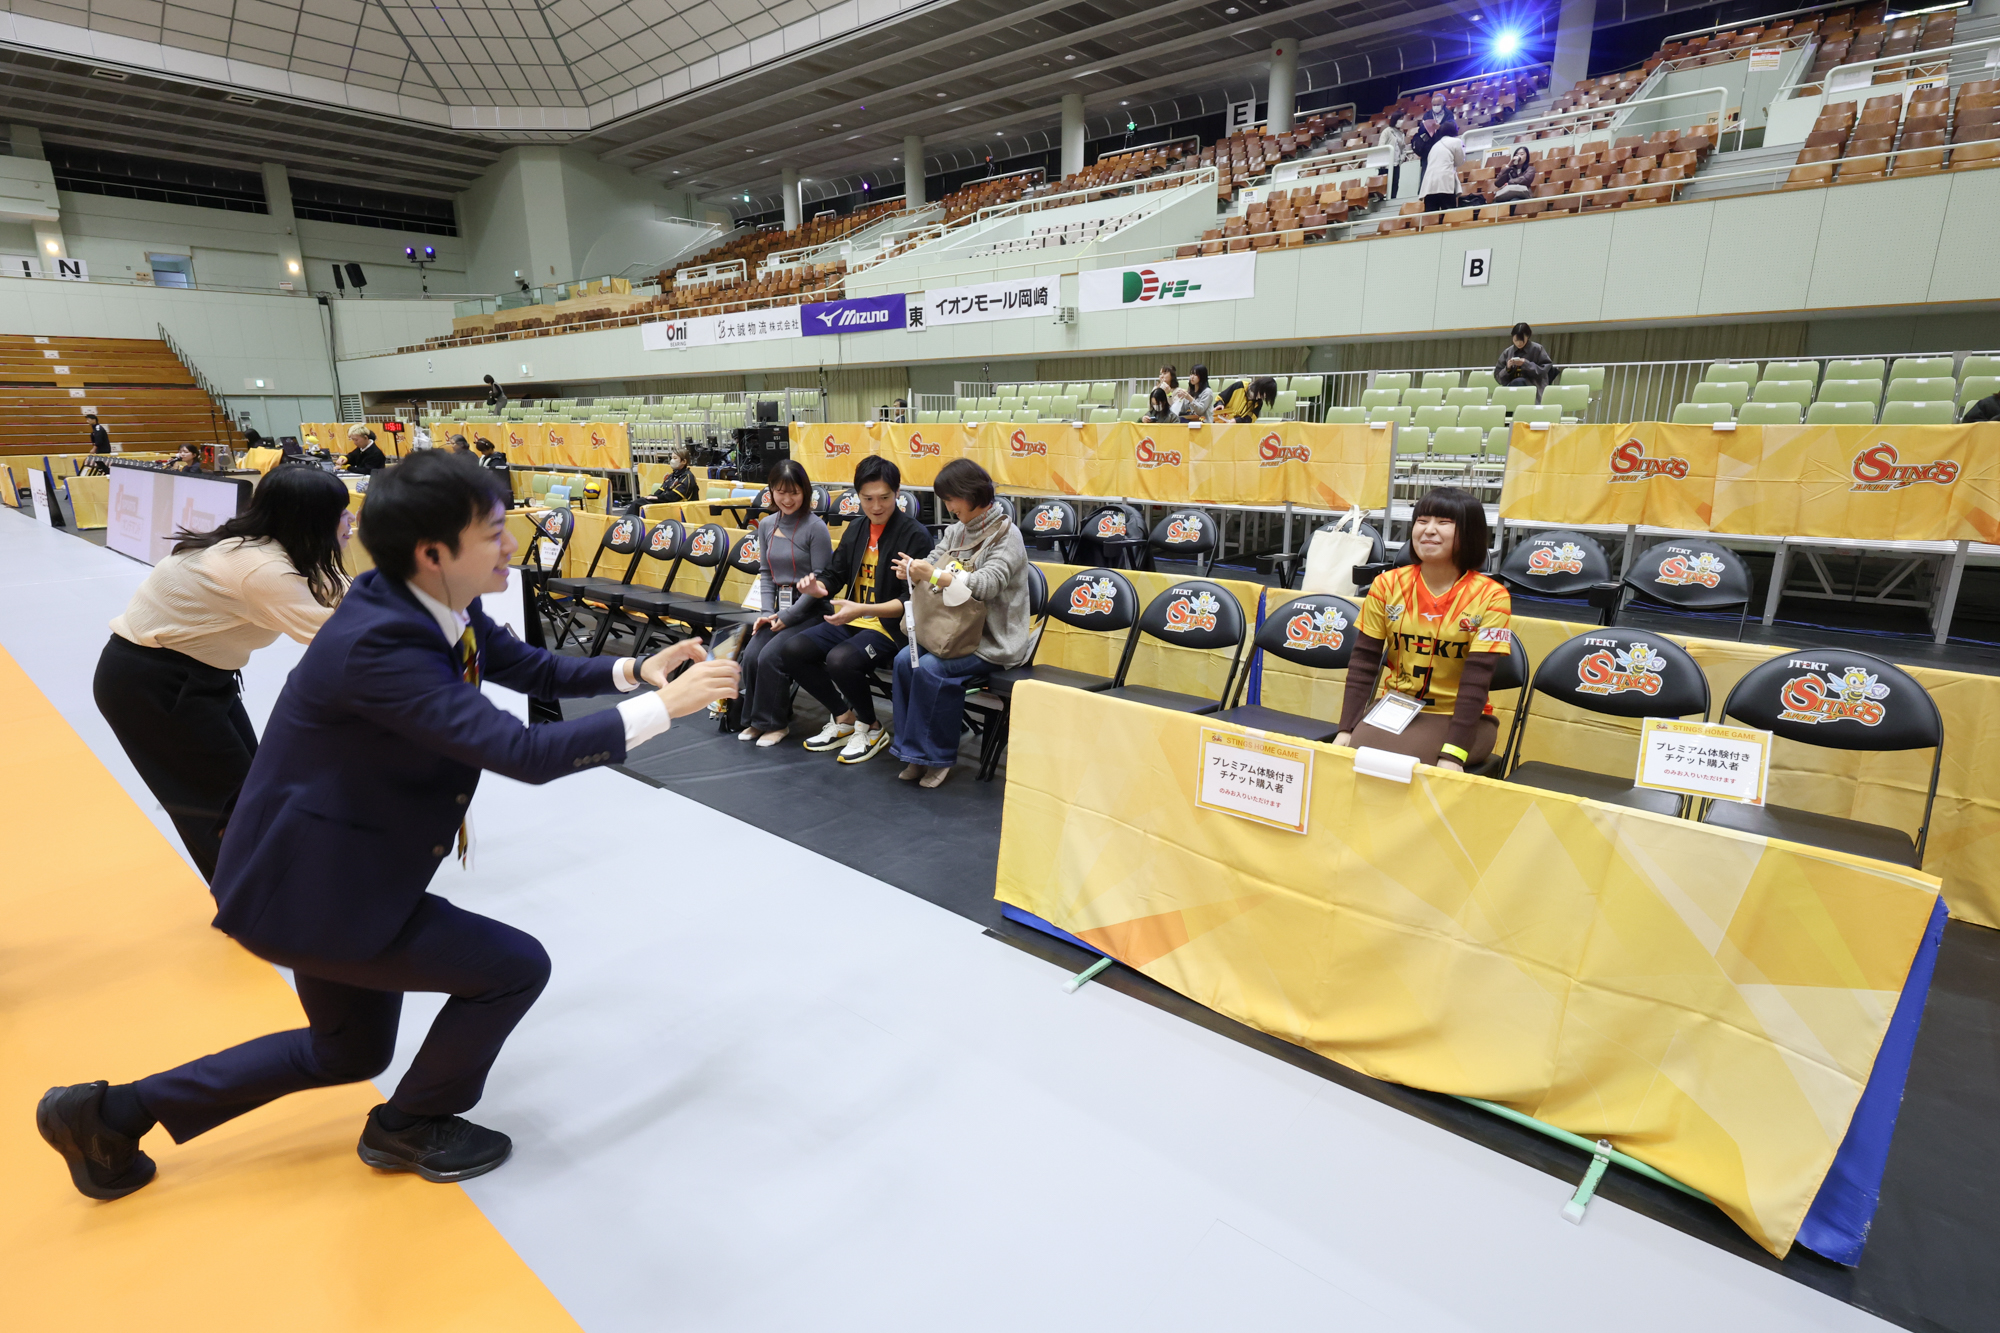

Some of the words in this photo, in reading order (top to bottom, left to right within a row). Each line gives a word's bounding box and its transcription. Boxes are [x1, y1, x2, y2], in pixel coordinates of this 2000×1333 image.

[1233, 102, 1248, 125] E
[1469, 258, 1484, 277] B
[1158, 279, 1202, 299] ドミー
[935, 286, 1049, 316] イオンモール岡崎
[838, 309, 889, 326] MIZUNO
[908, 307, 924, 328] 東
[1853, 443, 1958, 487] STINGS
[1171, 588, 1193, 596] JTEKT
[1292, 602, 1317, 611] JTEKT
[1584, 637, 1618, 648] JTEKT
[1787, 659, 1829, 671] JTEKT
[1781, 673, 1886, 726] STINGS
[1673, 725, 1703, 733] STINGS
[1704, 728, 1730, 737] HOME
[1731, 732, 1756, 740] GAME
[1226, 737, 1253, 749] STINGS
[1254, 743, 1275, 754] HOME
[1277, 748, 1299, 759] GAME
[1656, 742, 1750, 762] プレミアム体験付き
[1212, 756, 1294, 784] プレミアム体験付き
[1665, 754, 1739, 771] チケット購入者
[1220, 770, 1284, 794] チケット購入者
[1664, 769, 1736, 784] のみお入りいただけます
[1219, 787, 1281, 808] のみお入りいただけます
